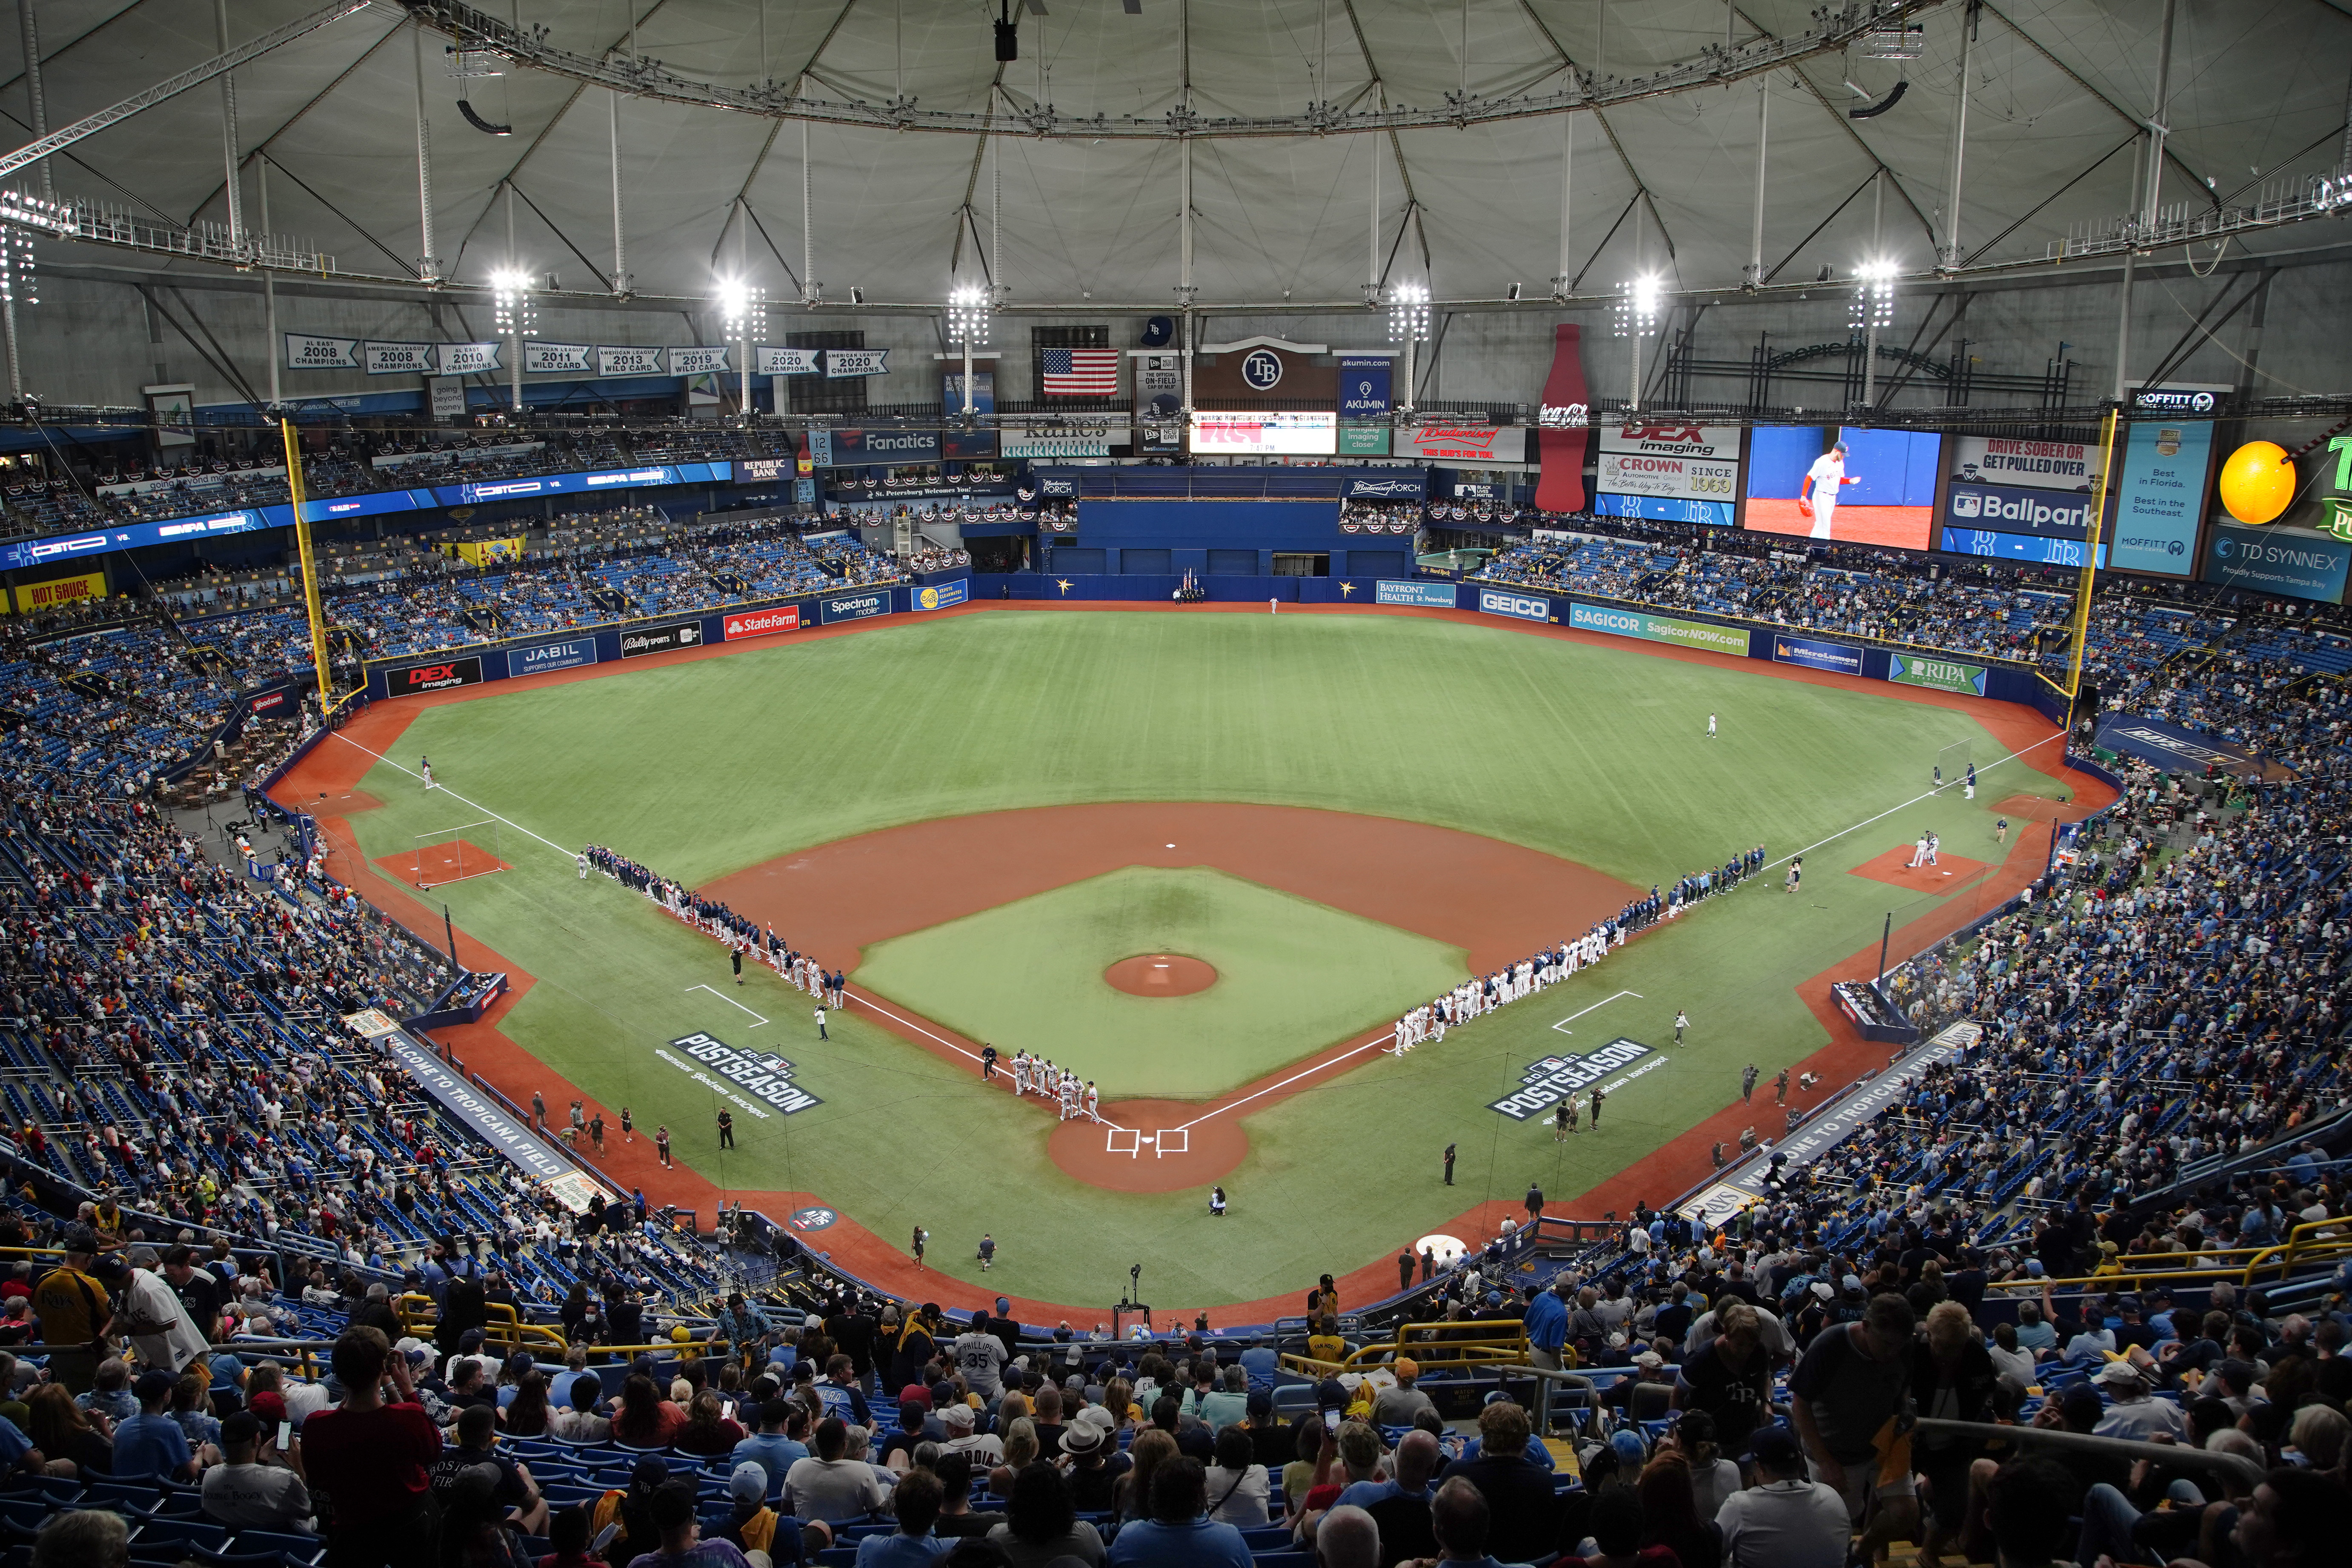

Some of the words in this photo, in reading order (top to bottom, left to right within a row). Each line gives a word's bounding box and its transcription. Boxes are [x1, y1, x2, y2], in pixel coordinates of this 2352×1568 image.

[304, 347, 337, 358] 2008
[381, 352, 413, 363] 2008
[454, 353, 483, 364] 2010
[541, 352, 570, 362] 2011
[296, 358, 347, 366] CHAMPIONS
[613, 355, 643, 365] 2013
[683, 355, 712, 365] 2019
[772, 357, 801, 365] 2020
[840, 358, 870, 366] 2020
[1342, 359, 1390, 367] akumin.com
[446, 363, 492, 371] CHAMPIONS
[1250, 357, 1276, 382] TB
[436, 386, 458, 395] going
[433, 394, 462, 403] beyond
[1345, 400, 1385, 409] AKUMIN
[435, 403, 461, 411] money
[814, 437, 826, 449] 12
[866, 433, 935, 451] Fanatics
[1348, 433, 1379, 441] imaging
[1423, 449, 1438, 457] THIS
[1440, 449, 1461, 458] BUD'S
[1463, 450, 1477, 458] FOR
[1478, 450, 1495, 459] YOU.
[1640, 440, 1715, 456] imaging
[1988, 439, 2023, 454] DRIVE
[2023, 441, 2064, 458] SOBER
[2066, 445, 2084, 460] OR
[814, 452, 828, 464] 66
[744, 460, 785, 470] REPUBLIC
[1620, 458, 1683, 474] CROWN
[1983, 455, 2006, 469] GET
[2007, 456, 2052, 473] PULLED
[2052, 460, 2085, 476] OVER
[753, 468, 778, 478] BANK
[1691, 466, 1731, 478] SINCE
[2153, 469, 2175, 477] Best
[1358, 484, 1392, 492] Budweiser
[1391, 484, 1421, 492] PORCH
[1690, 476, 1731, 493] 1969
[2139, 477, 2148, 485] in
[2150, 478, 2185, 488] Florida.
[886, 488, 923, 497] Petersburg
[924, 487, 955, 495] Welcomes
[2134, 496, 2156, 505] Best
[2169, 500, 2185, 508] the
[1983, 496, 2099, 528] Ballpark
[2132, 506, 2184, 518] Southeast.
[2121, 537, 2167, 548] MOFFITT
[2240, 543, 2263, 560] TD
[2266, 547, 2338, 572] SYNNEX
[2222, 566, 2249, 578] Proudly
[2251, 570, 2284, 582] Supports
[2286, 575, 2310, 587] Tampa
[2312, 579, 2326, 589] Bay
[31, 586, 52, 604] HOT
[55, 580, 89, 600] SAUCE
[939, 589, 962, 599] CLEARWATER
[1380, 583, 1425, 595] BAYFRONT
[1380, 592, 1414, 602] HEALTH
[1425, 595, 1453, 605] Petersburg
[832, 598, 877, 614] Spectrum
[856, 607, 877, 617] mobile
[1483, 594, 1547, 618] GEICO
[1574, 609, 1639, 632] SAGICOR
[1647, 621, 1745, 647] SagicorNOW.com
[623, 637, 650, 650] Bally
[650, 635, 670, 645] SPORTS
[526, 644, 579, 662] JABIL
[1794, 647, 1858, 664] MicroLumen
[524, 663, 546, 672] SUPPORTS
[557, 657, 583, 667] COMMUNITY
[409, 664, 456, 684] DEX
[1926, 662, 1967, 683] RIPA
[421, 677, 462, 689] imaging
[739, 1049, 757, 1059] 20
[1563, 1054, 1582, 1063] 21
[675, 1033, 817, 1113] POSTSEASON
[775, 1069, 793, 1079] 21
[1494, 1040, 1649, 1118] POSTSEASON
[1522, 1073, 1542, 1084] 20
[1813, 1122, 1841, 1138] TO
[1834, 1072, 1912, 1122] TROPICANA
[1907, 1046, 1949, 1074] FIELD
[432, 1073, 455, 1089] TO
[448, 1087, 519, 1144] TROPICANA
[515, 1142, 562, 1176] FIELD
[803, 1210, 830, 1226] ALDS
[963, 1342, 993, 1353] PHILLIPS
[1324, 1342, 1337, 1351] HOST
[967, 1353, 988, 1369] 35
